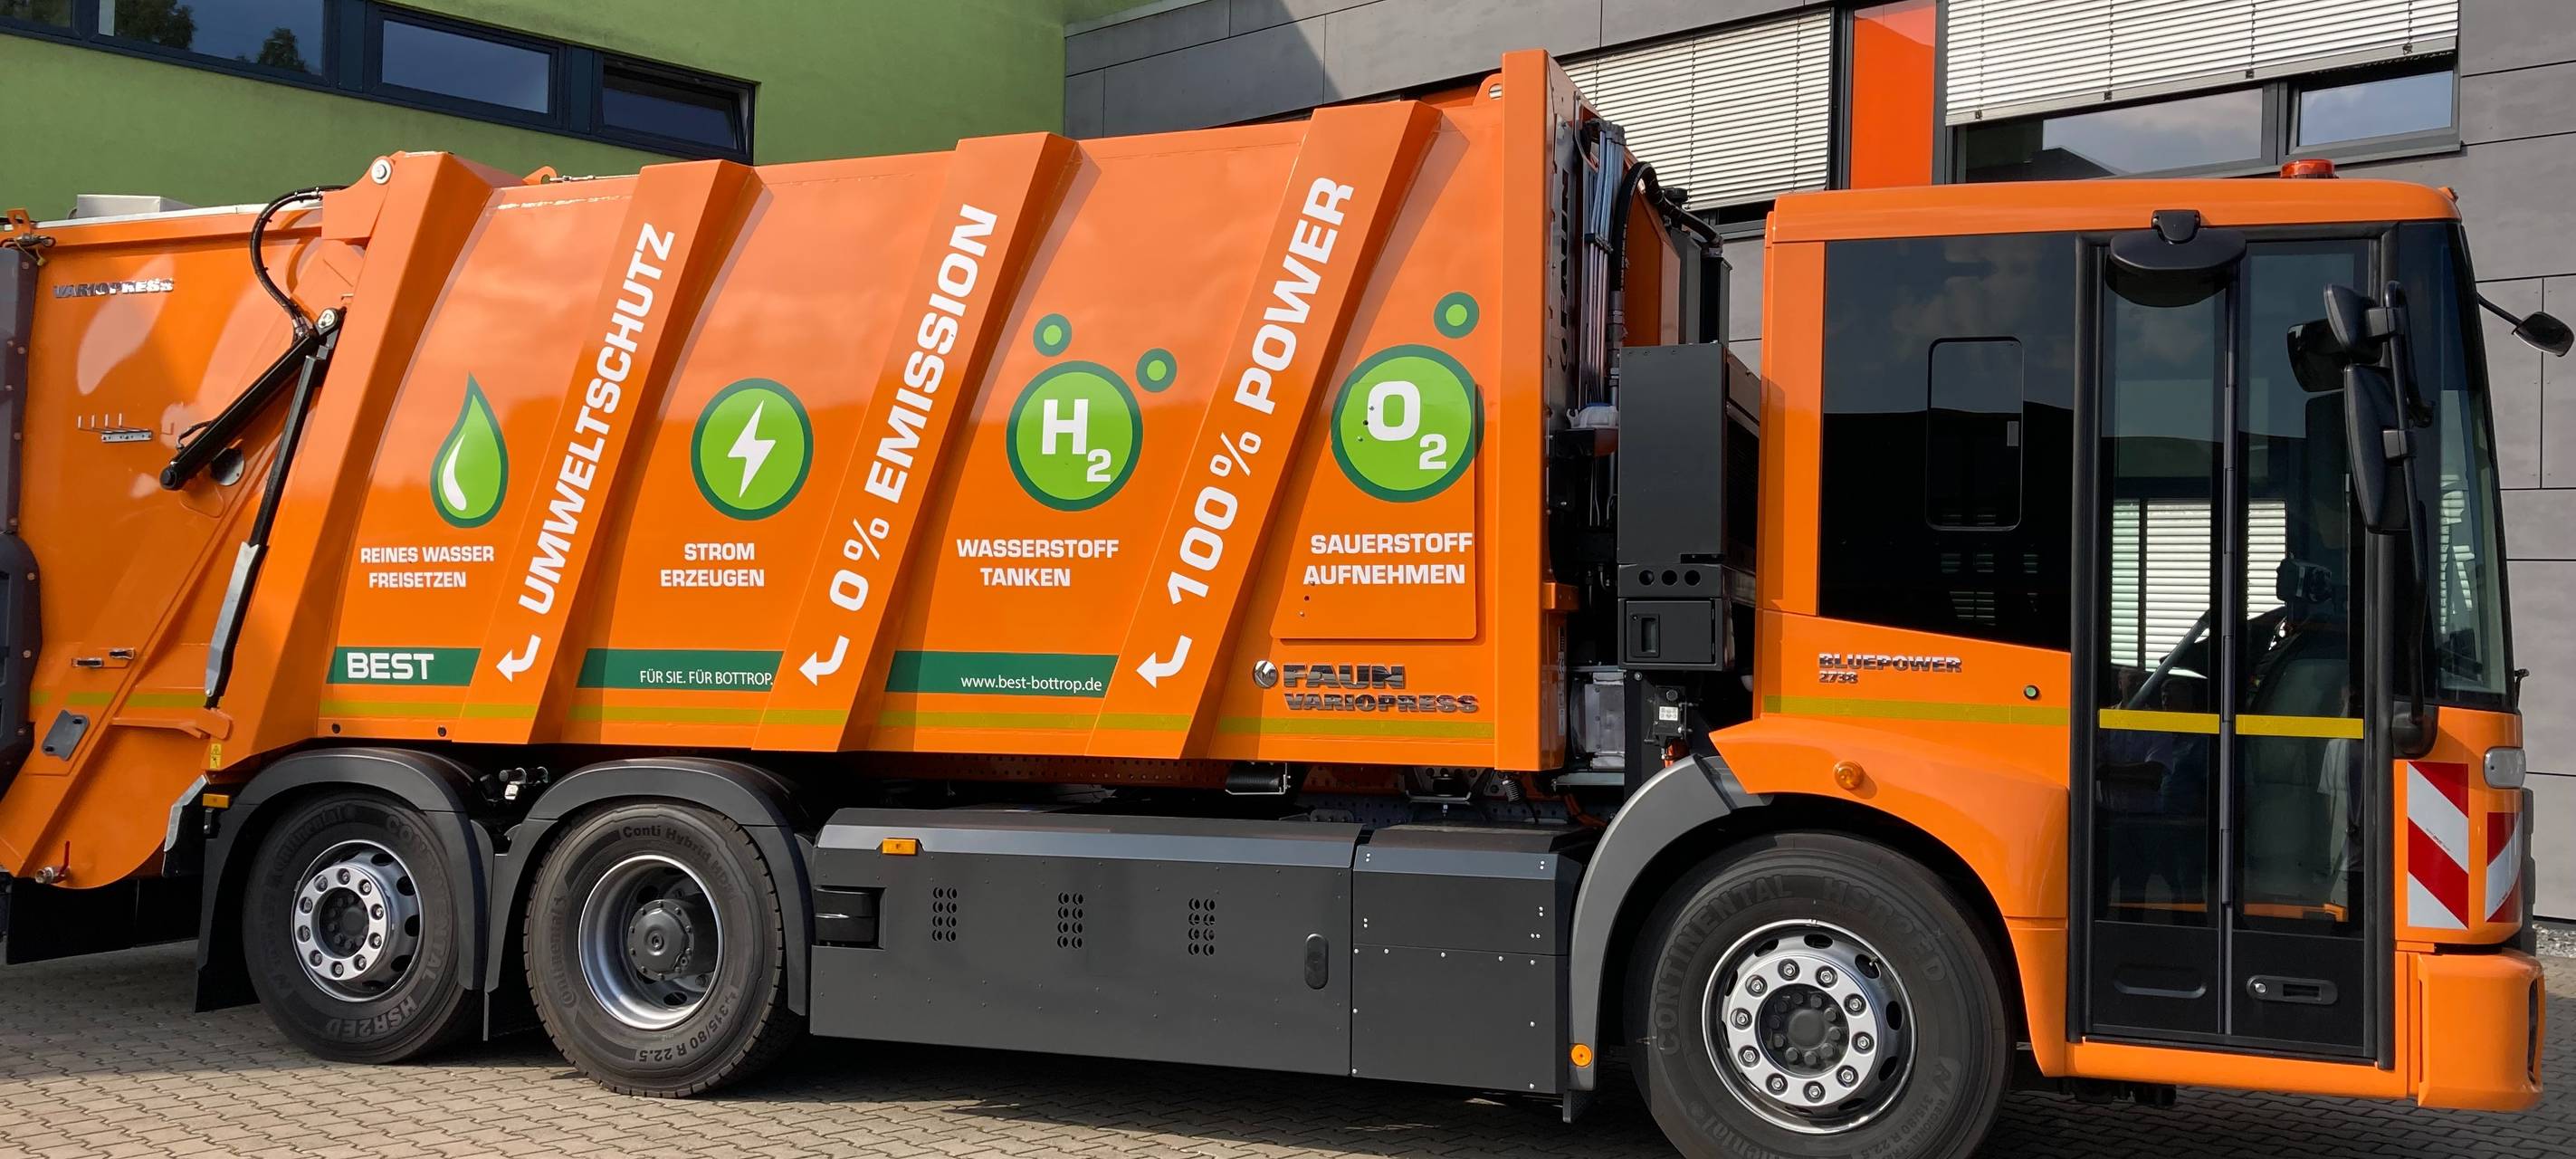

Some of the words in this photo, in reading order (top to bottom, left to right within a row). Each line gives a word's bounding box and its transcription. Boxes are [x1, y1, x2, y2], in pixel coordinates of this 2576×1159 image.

[54, 278, 175, 298] VARIOPRESS
[1234, 177, 1354, 415] POWER
[864, 204, 997, 503] EMISSION
[518, 222, 675, 615] UMWELTSCHUTZ
[683, 542, 756, 560] STROM
[956, 539, 1120, 559] WASSERSTOFF
[1310, 532, 1474, 554] SAUERSTOFF
[360, 546, 418, 564] REINES
[422, 545, 494, 563] WASSER
[368, 570, 466, 589] FREISETZEN
[660, 569, 766, 588] ERZEUGEN
[980, 567, 1072, 587] TANKEN
[1302, 563, 1466, 586] AUFNEHMEN
[346, 652, 434, 681] BEST
[1818, 653, 1962, 673] BLUEPOWER
[639, 668, 664, 685] FÜR
[666, 669, 686, 685] SIE.
[688, 669, 712, 685] FÜR
[714, 670, 775, 686] BOTTROP.
[960, 674, 1103, 695] www.best-bottrop.de
[1282, 664, 1405, 689] FAUN
[1818, 670, 1858, 685] 2738
[1283, 693, 1480, 713] VARIOPRESS
[622, 825, 662, 840] Conti
[1655, 874, 1793, 1056] CONTINENTAL
[689, 1004, 730, 1049] 315/80
[638, 1047, 674, 1062] 22.5
